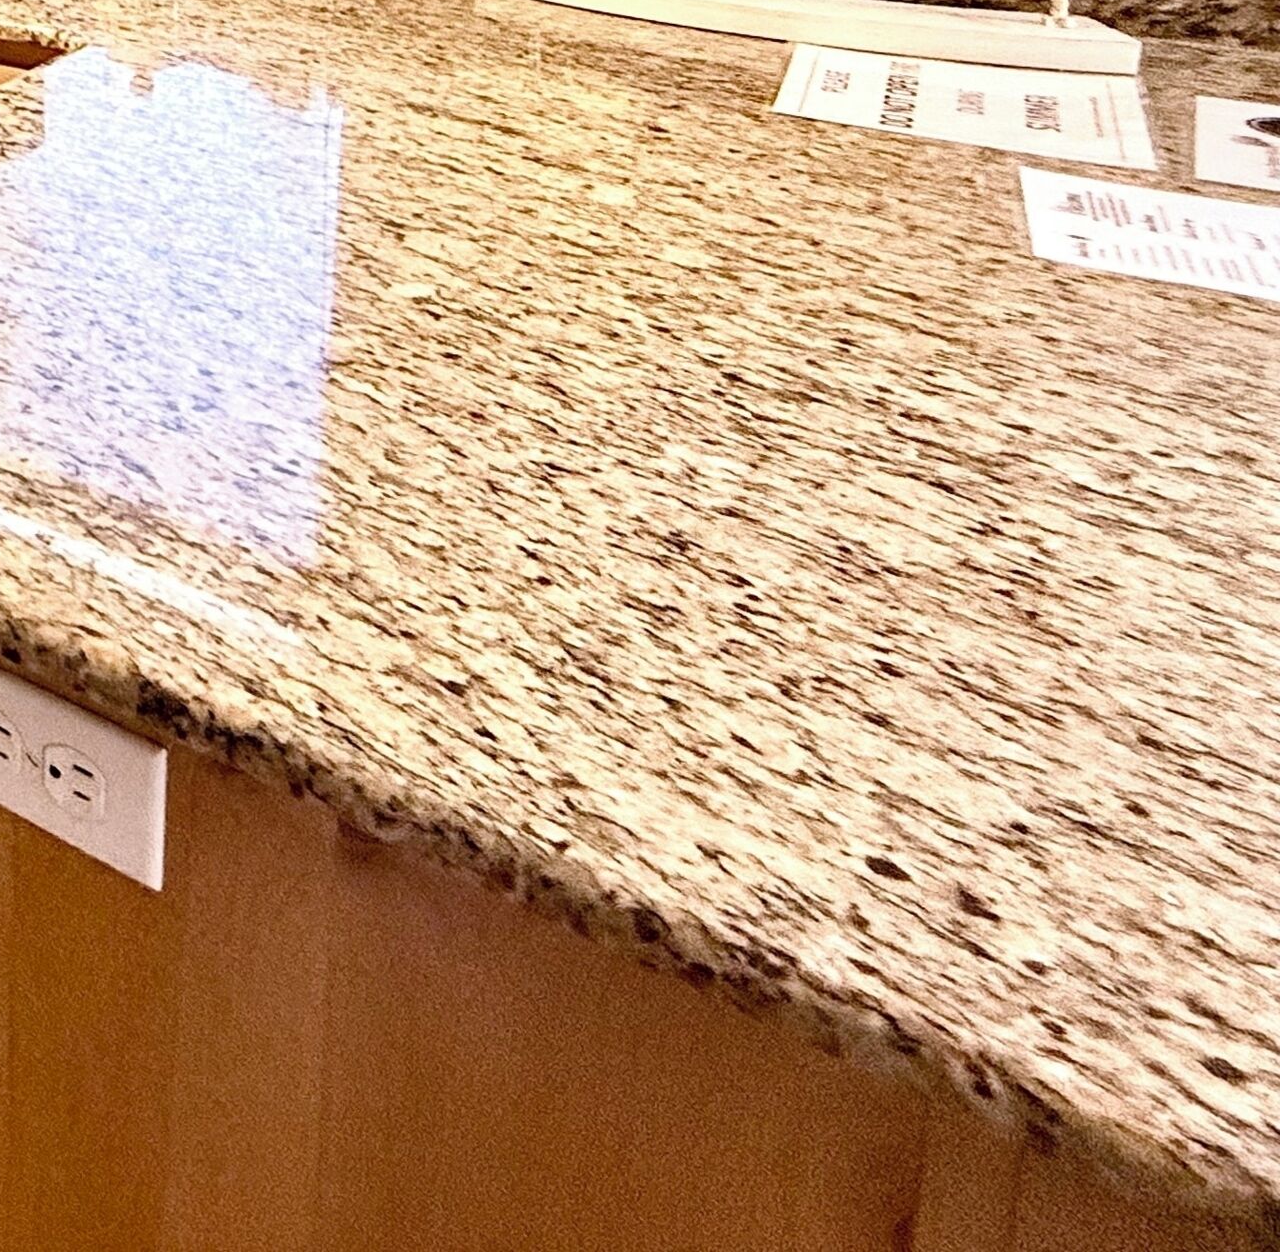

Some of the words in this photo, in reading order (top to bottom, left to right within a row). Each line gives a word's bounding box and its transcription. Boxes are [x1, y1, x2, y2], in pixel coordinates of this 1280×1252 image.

[886, 74, 920, 97] OPEN
[883, 94, 917, 114] NOT
[879, 112, 915, 129] DO
